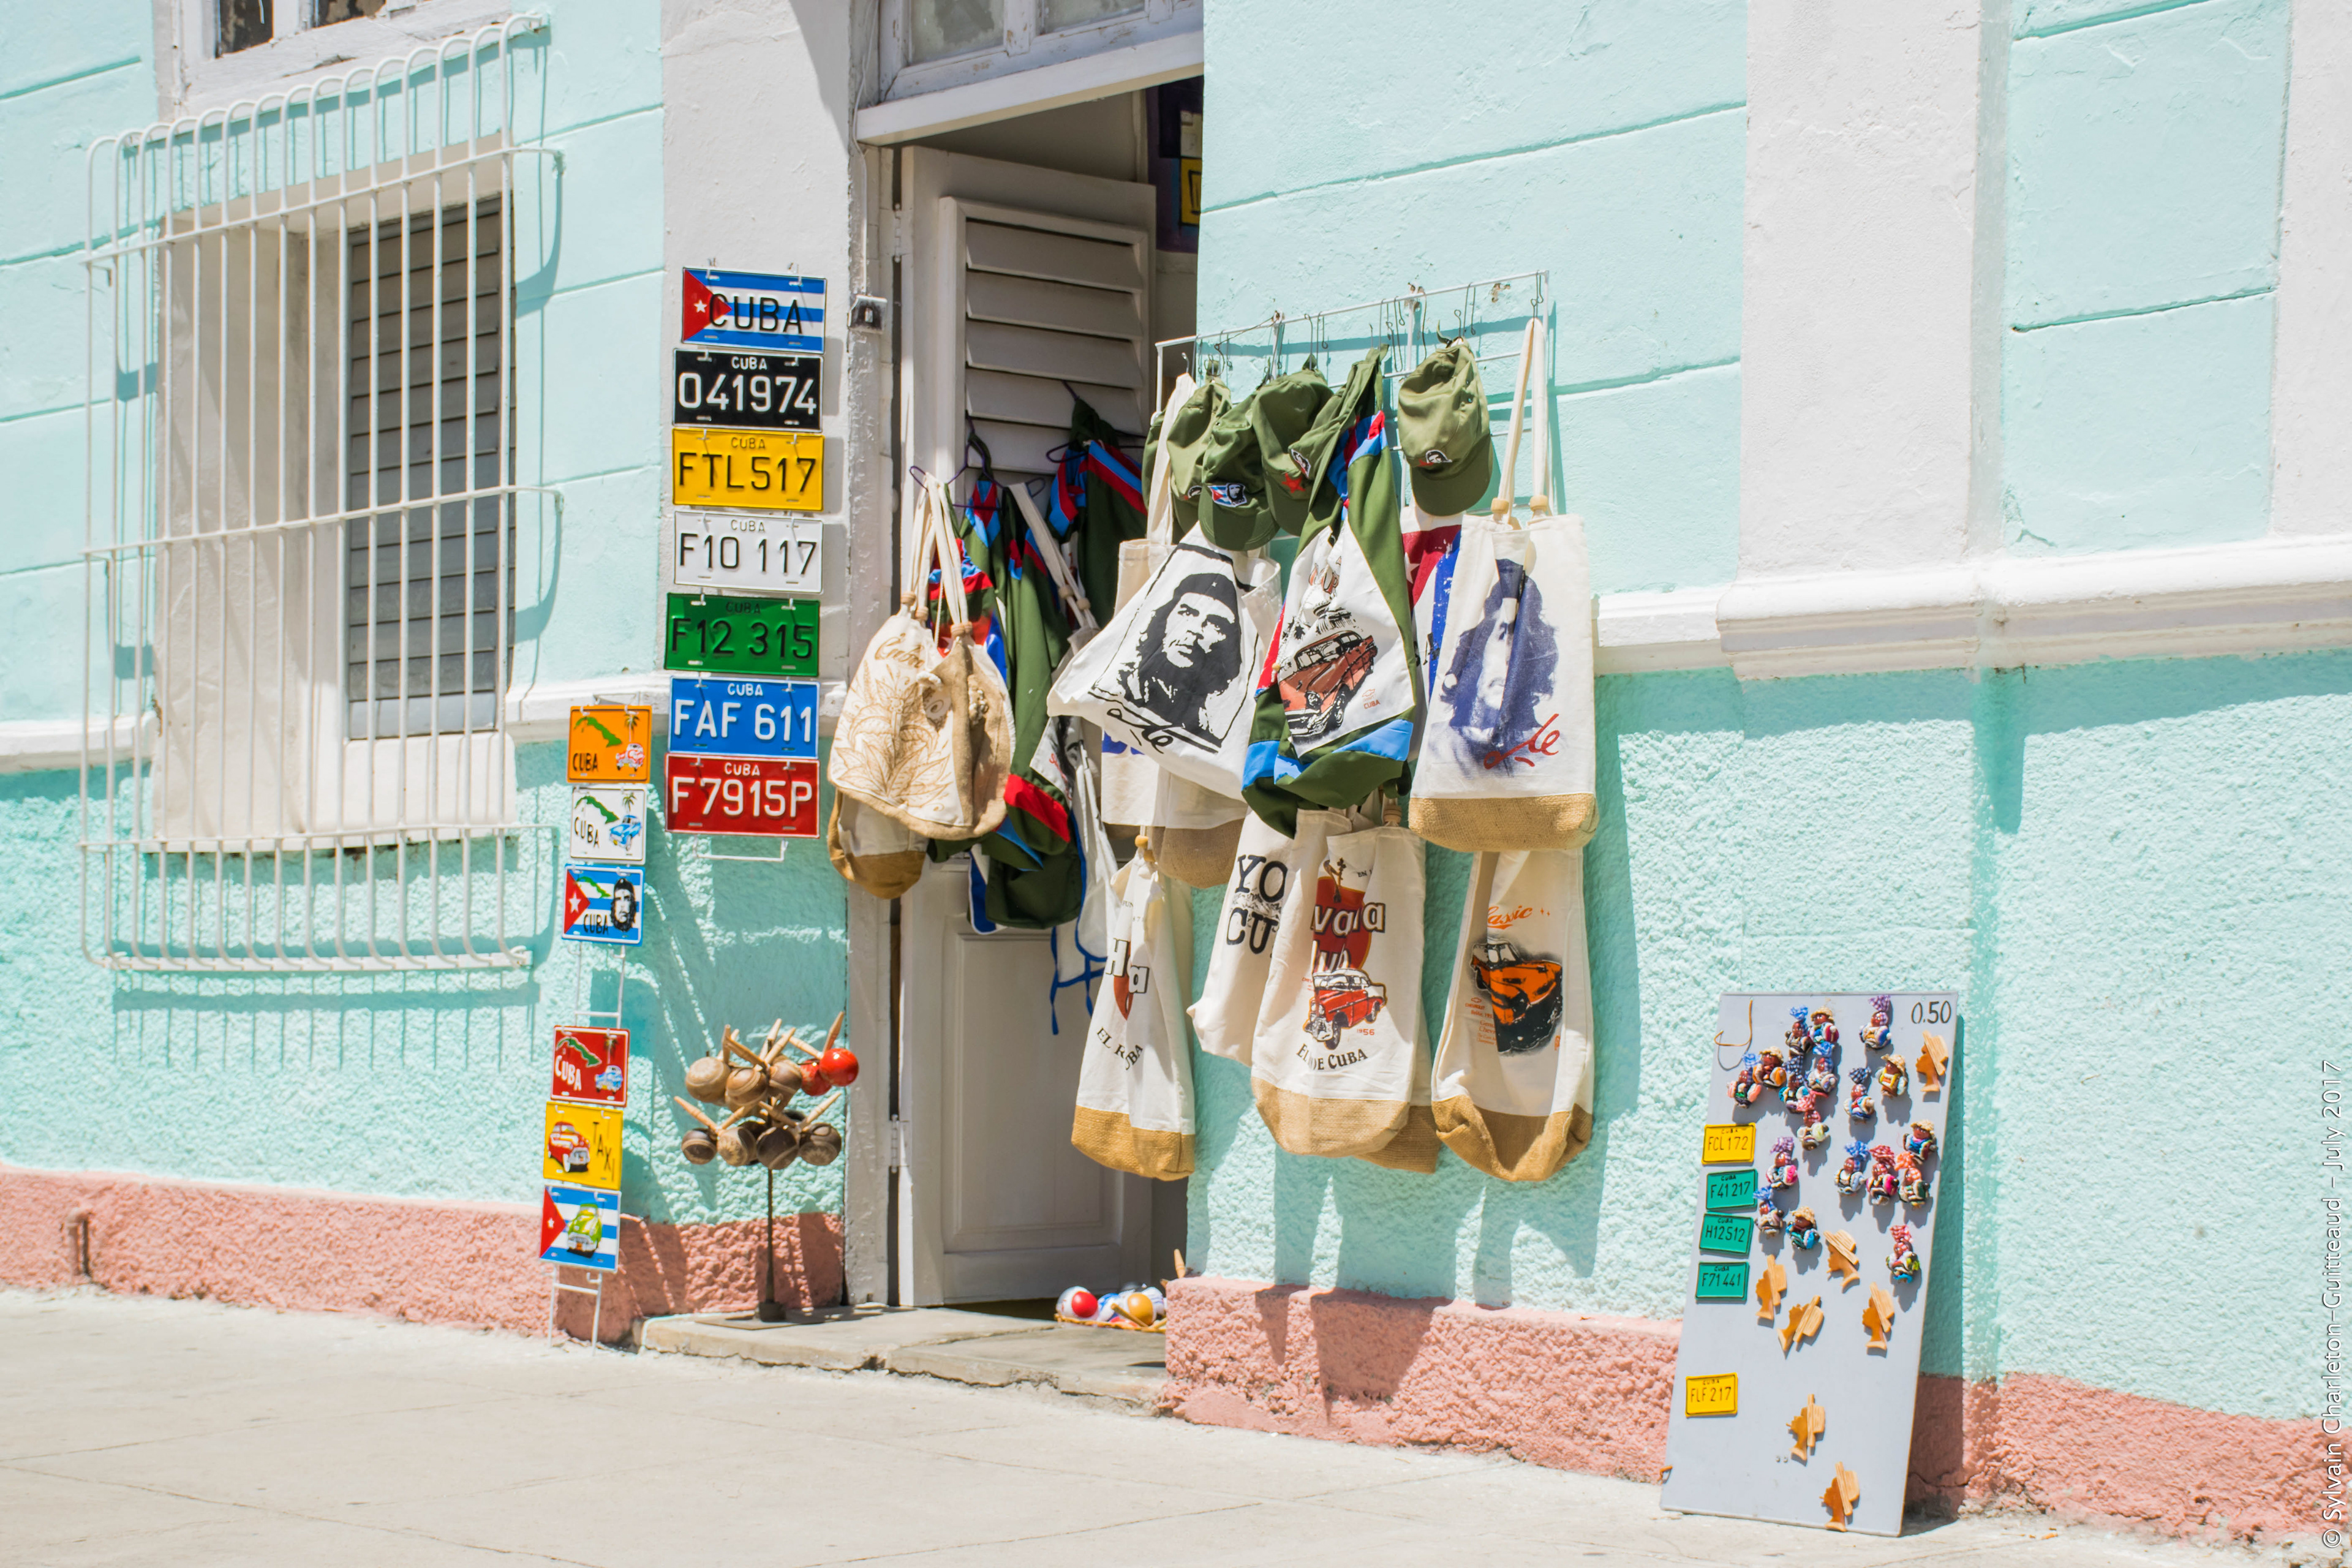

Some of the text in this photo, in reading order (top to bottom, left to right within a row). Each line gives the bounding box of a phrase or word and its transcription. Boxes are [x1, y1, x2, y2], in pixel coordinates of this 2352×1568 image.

[709, 293, 802, 334] CUBA
[731, 356, 767, 371] CUBA
[731, 437, 766, 449] CUBA
[731, 519, 766, 532] CUBA
[758, 538, 817, 575] 117
[726, 601, 761, 614] CUBA
[671, 617, 813, 660] F12 315
[727, 682, 763, 696] CUBA
[1363, 699, 1381, 709] CUBA
[674, 699, 812, 742] FAF 611
[573, 753, 598, 772] CUBA
[724, 762, 760, 776] CUBA
[671, 776, 813, 818] F7915P
[575, 816, 600, 848] CUBA
[583, 913, 609, 935] CUBA
[1227, 907, 1279, 954] CU
[1910, 1000, 1951, 1024] 0.50
[1096, 1027, 1112, 1049] EL
[1328, 1048, 1368, 1069] CUBA
[555, 1055, 582, 1091] CUBA
[592, 1121, 615, 1182] TAXI
